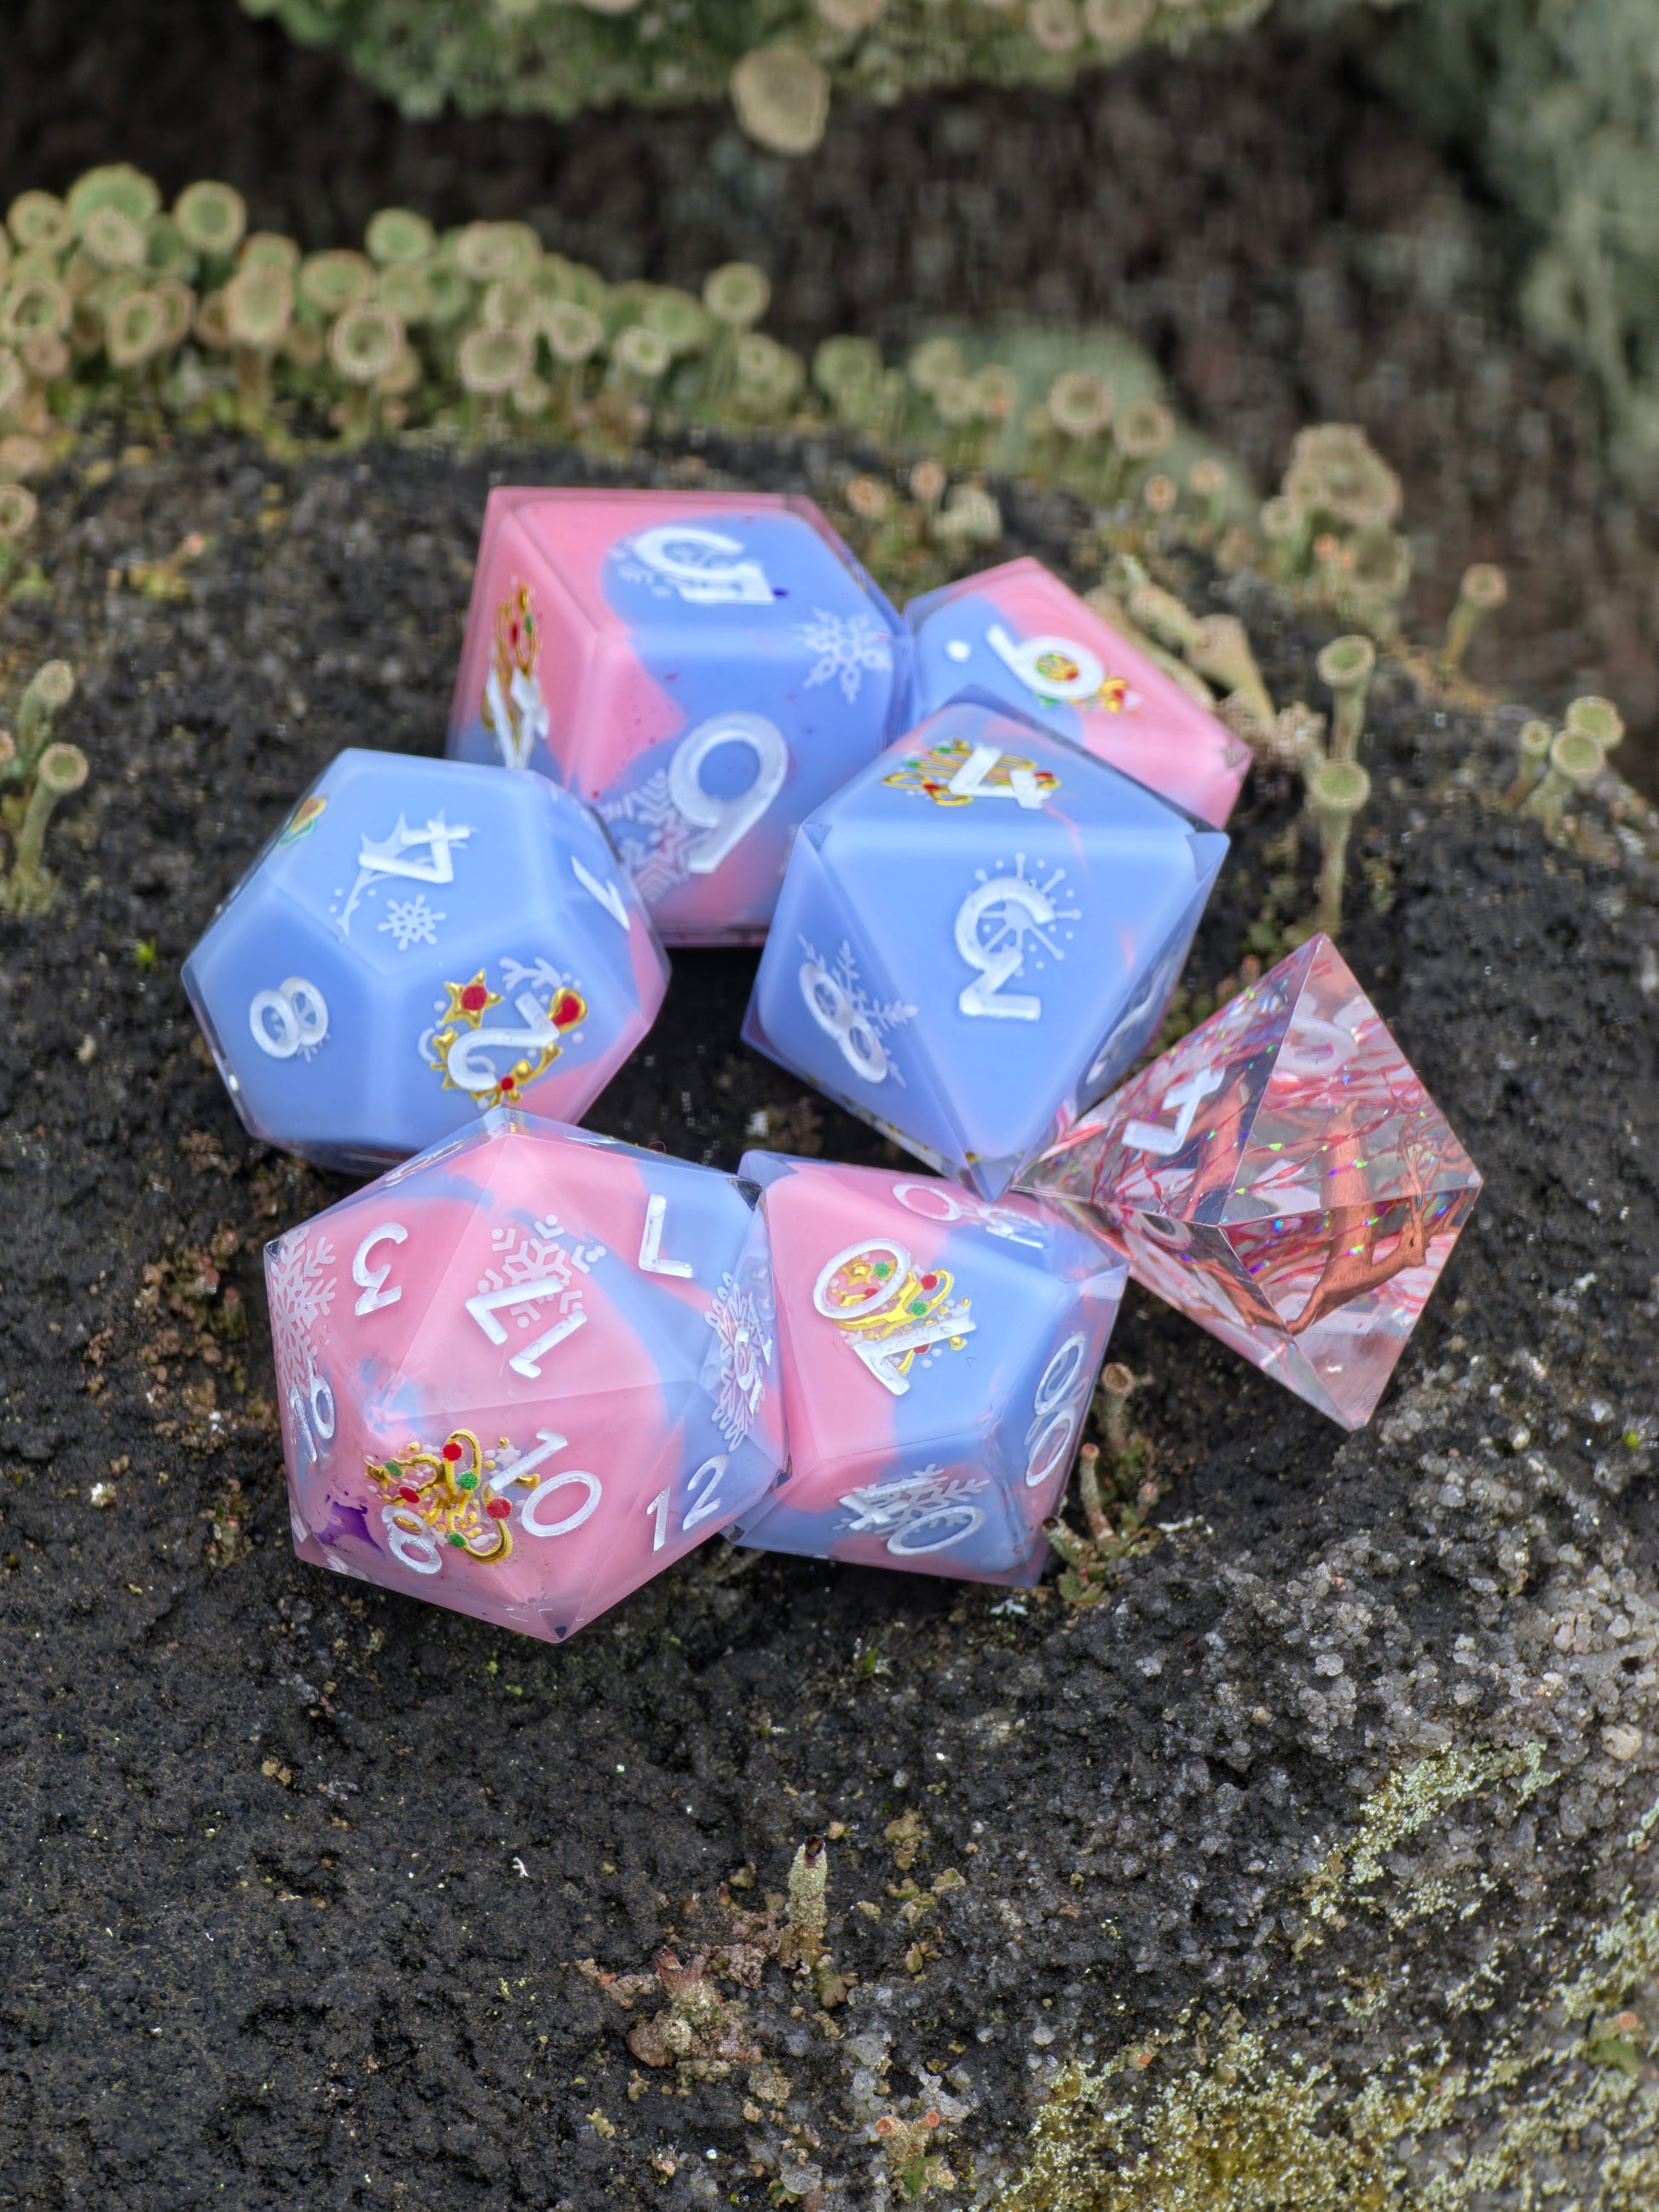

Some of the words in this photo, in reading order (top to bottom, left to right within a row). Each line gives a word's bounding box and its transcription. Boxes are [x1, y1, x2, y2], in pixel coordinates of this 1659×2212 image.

[250, 977, 328, 1058] 8
[447, 991, 560, 1090] 2
[799, 961, 887, 1083] 8
[488, 1429, 603, 1537] 10
[646, 1454, 729, 1552] 12
[381, 1505, 443, 1574] 8
